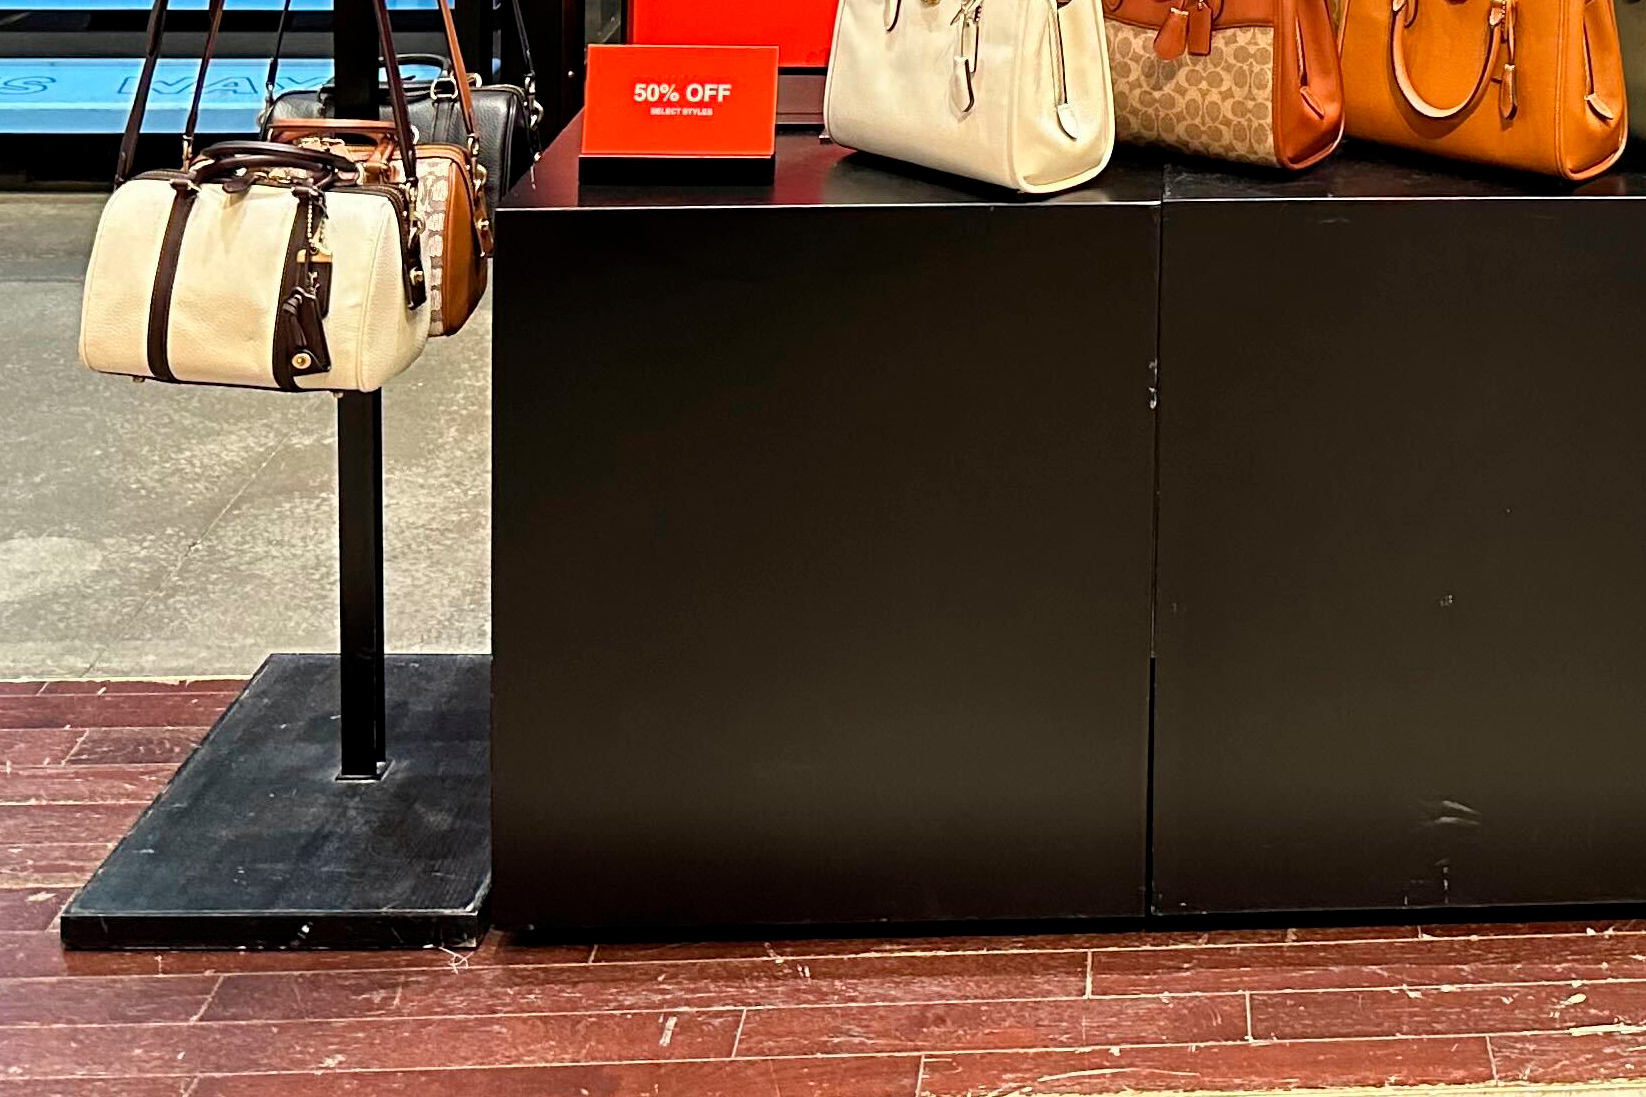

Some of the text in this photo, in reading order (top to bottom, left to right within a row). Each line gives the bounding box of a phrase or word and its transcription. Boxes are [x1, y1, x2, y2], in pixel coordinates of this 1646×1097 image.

[633, 83, 732, 103] 50% OFF
[650, 106, 681, 116] SELECT
